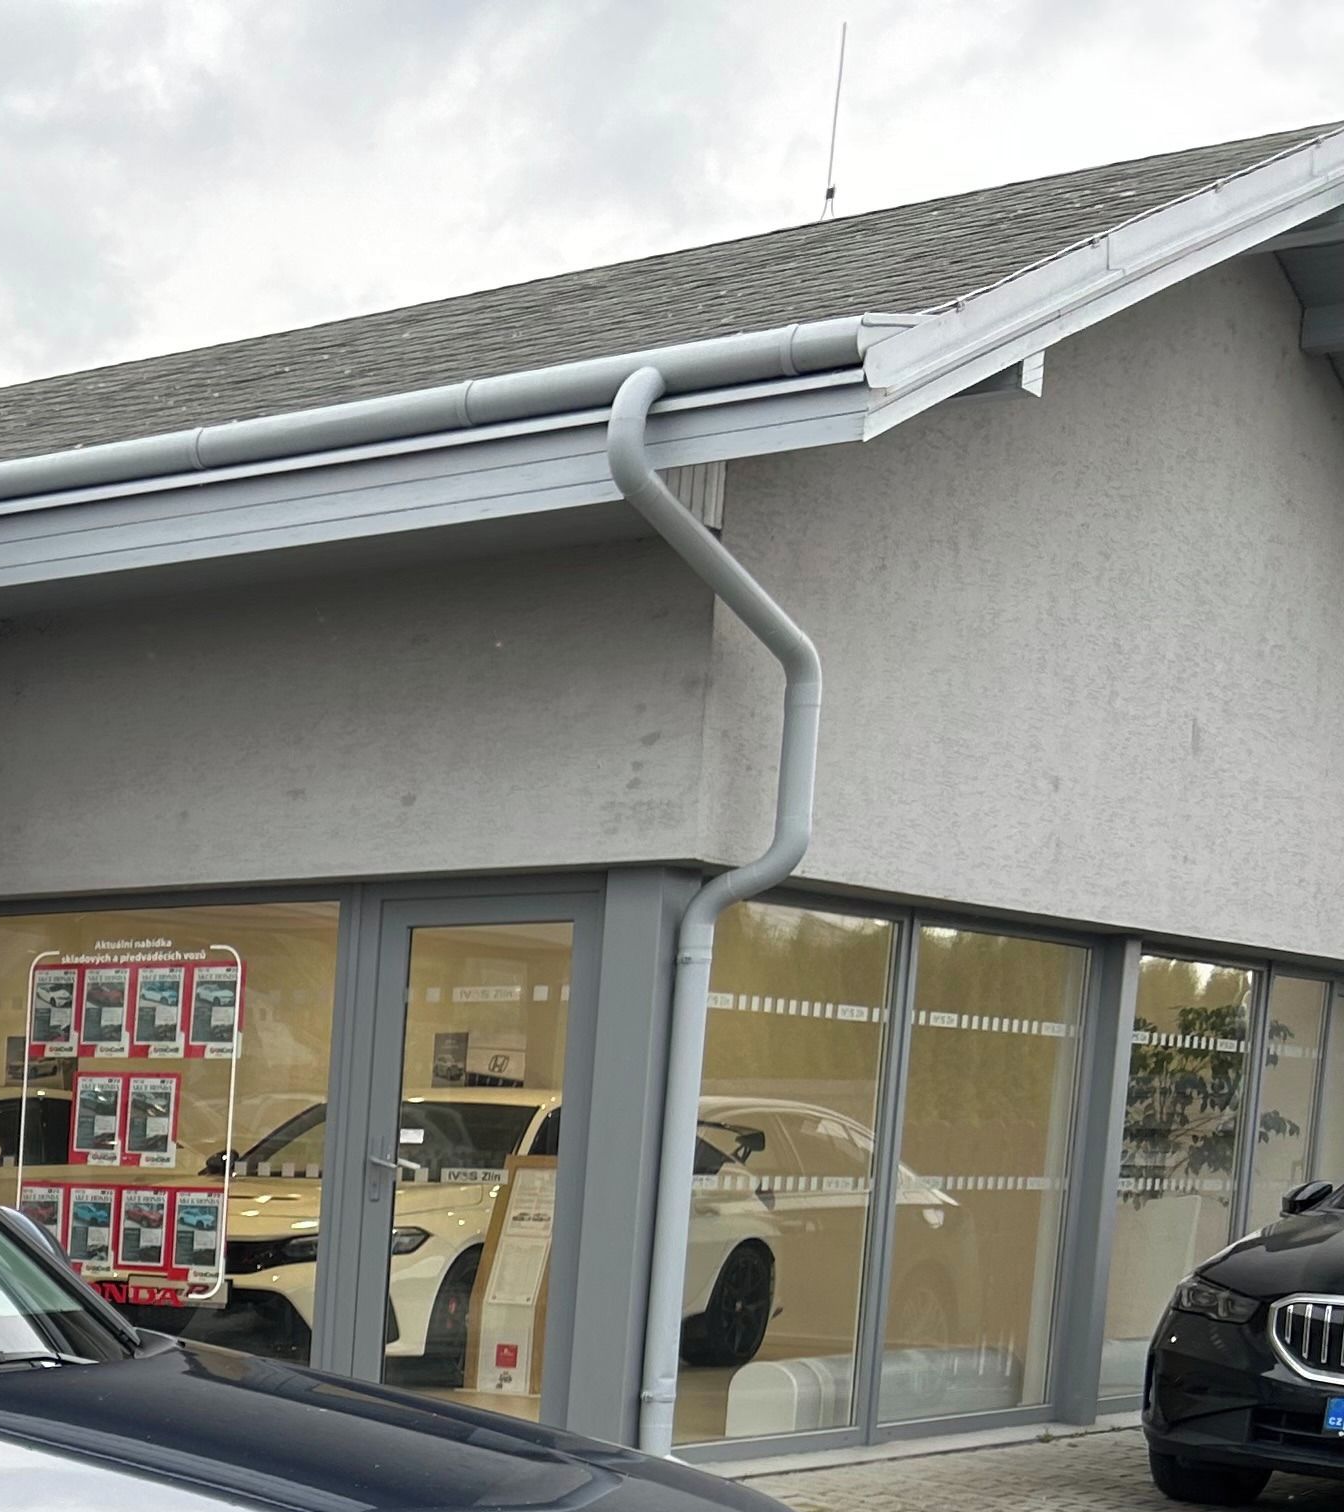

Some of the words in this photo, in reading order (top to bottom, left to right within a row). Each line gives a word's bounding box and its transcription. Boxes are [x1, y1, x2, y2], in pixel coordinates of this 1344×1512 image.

[95, 940, 133, 950] Aktuální
[134, 938, 172, 949] nabídka
[62, 953, 111, 964] skladových
[1328, 1416, 1343, 1426] CZ
